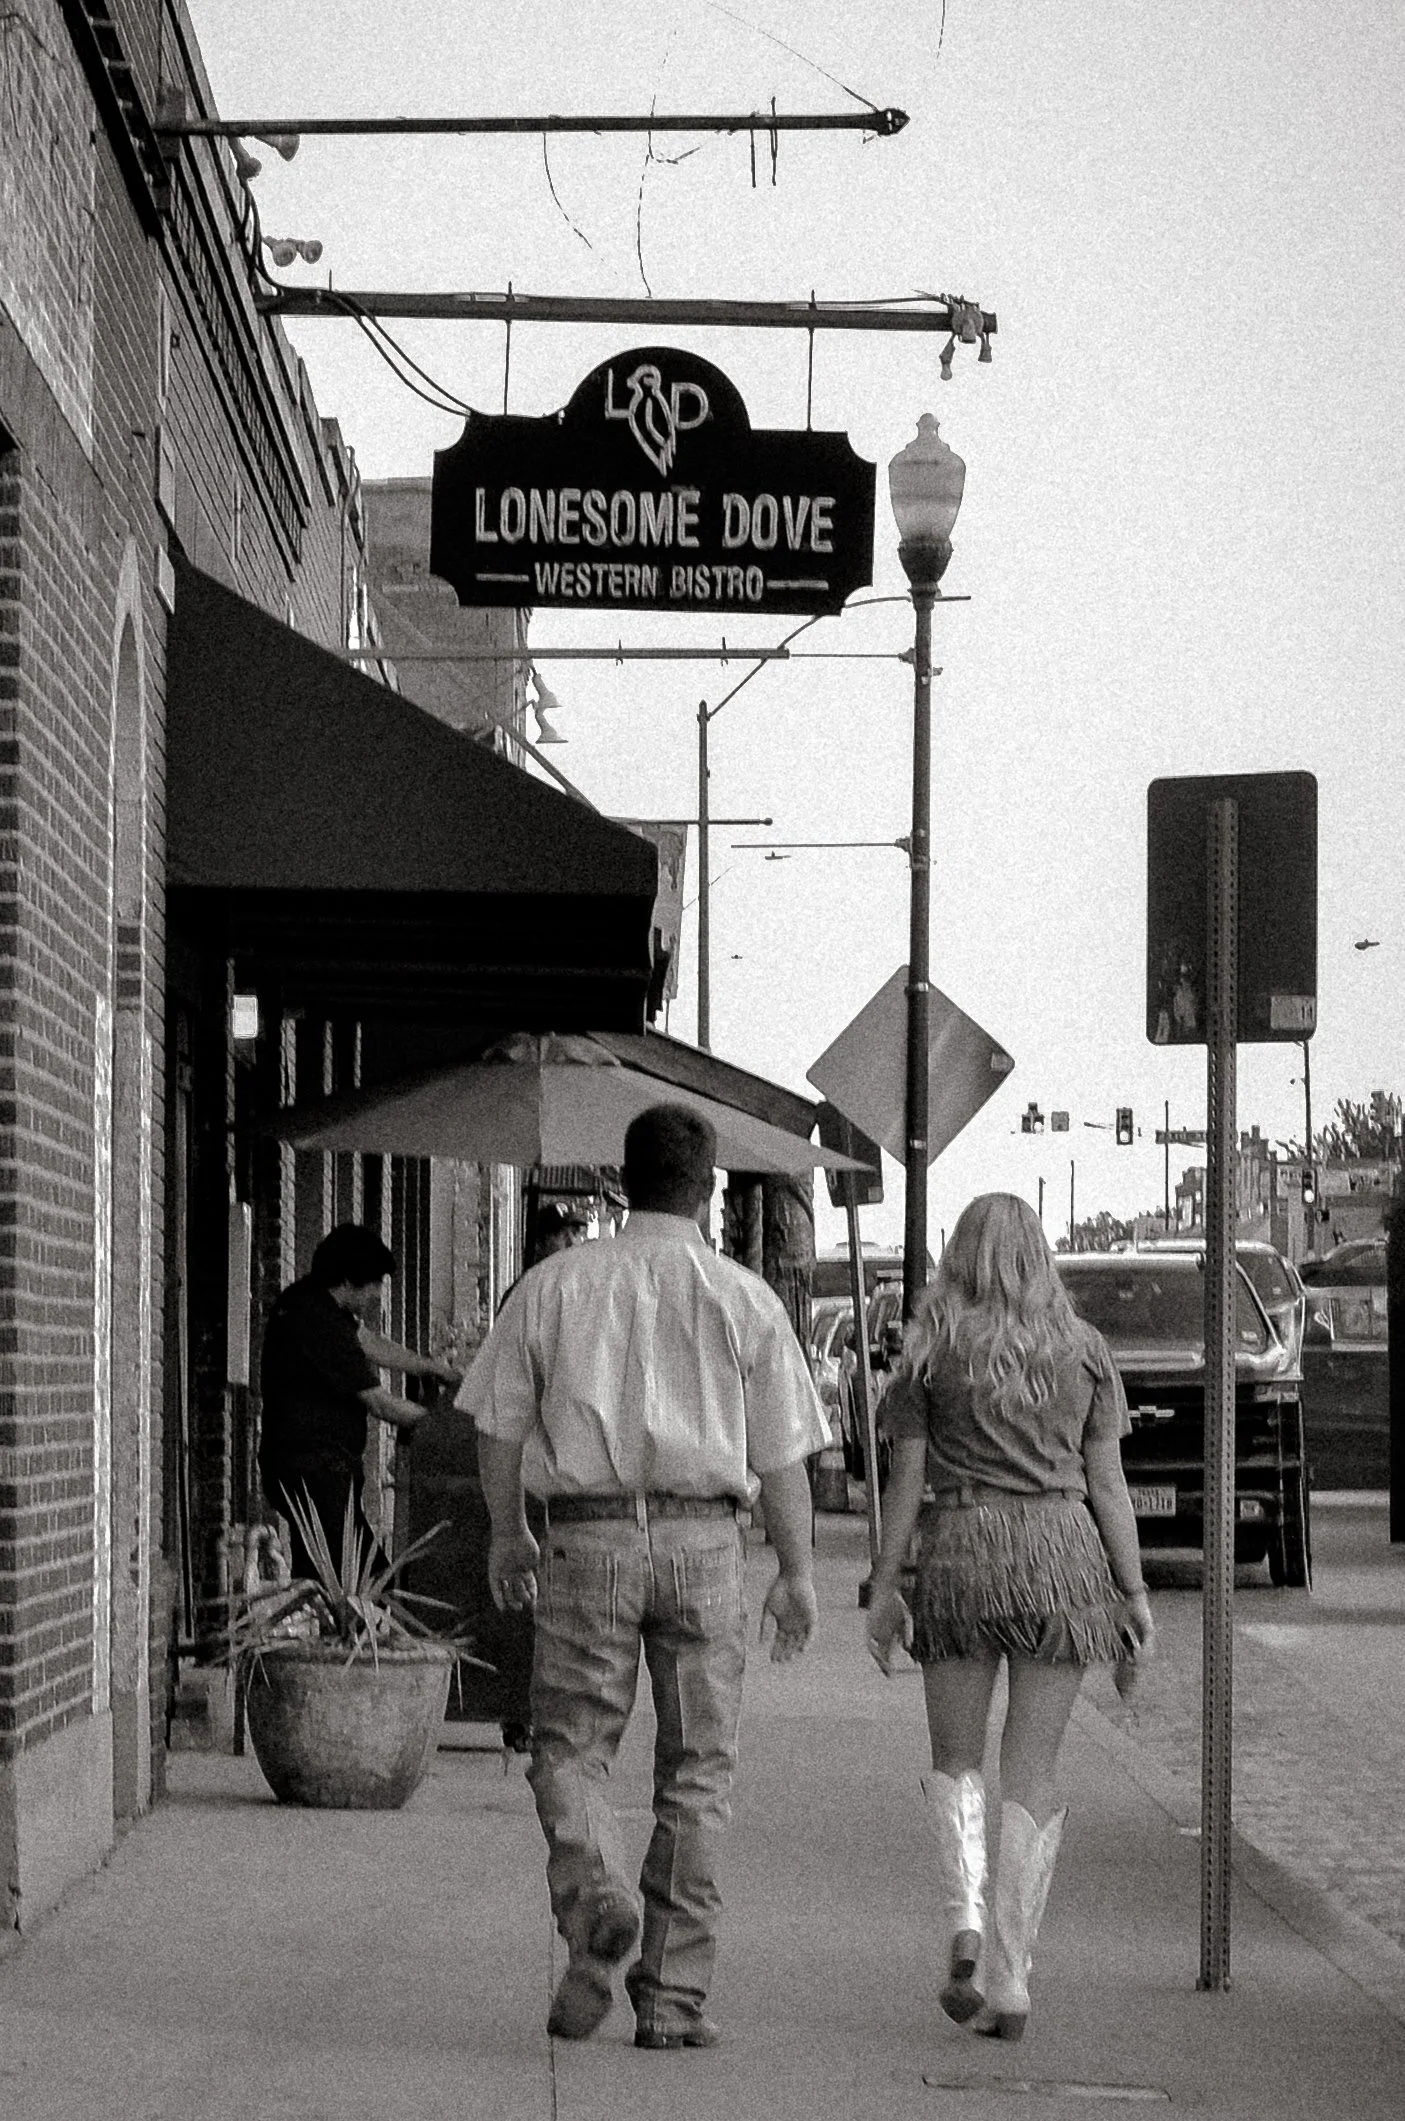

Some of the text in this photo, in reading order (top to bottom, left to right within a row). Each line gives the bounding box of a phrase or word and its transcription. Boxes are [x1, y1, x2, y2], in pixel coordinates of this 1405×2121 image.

[476, 487, 835, 553] LONESOME DOVE
[534, 561, 764, 600] WESTERN BISTRO
